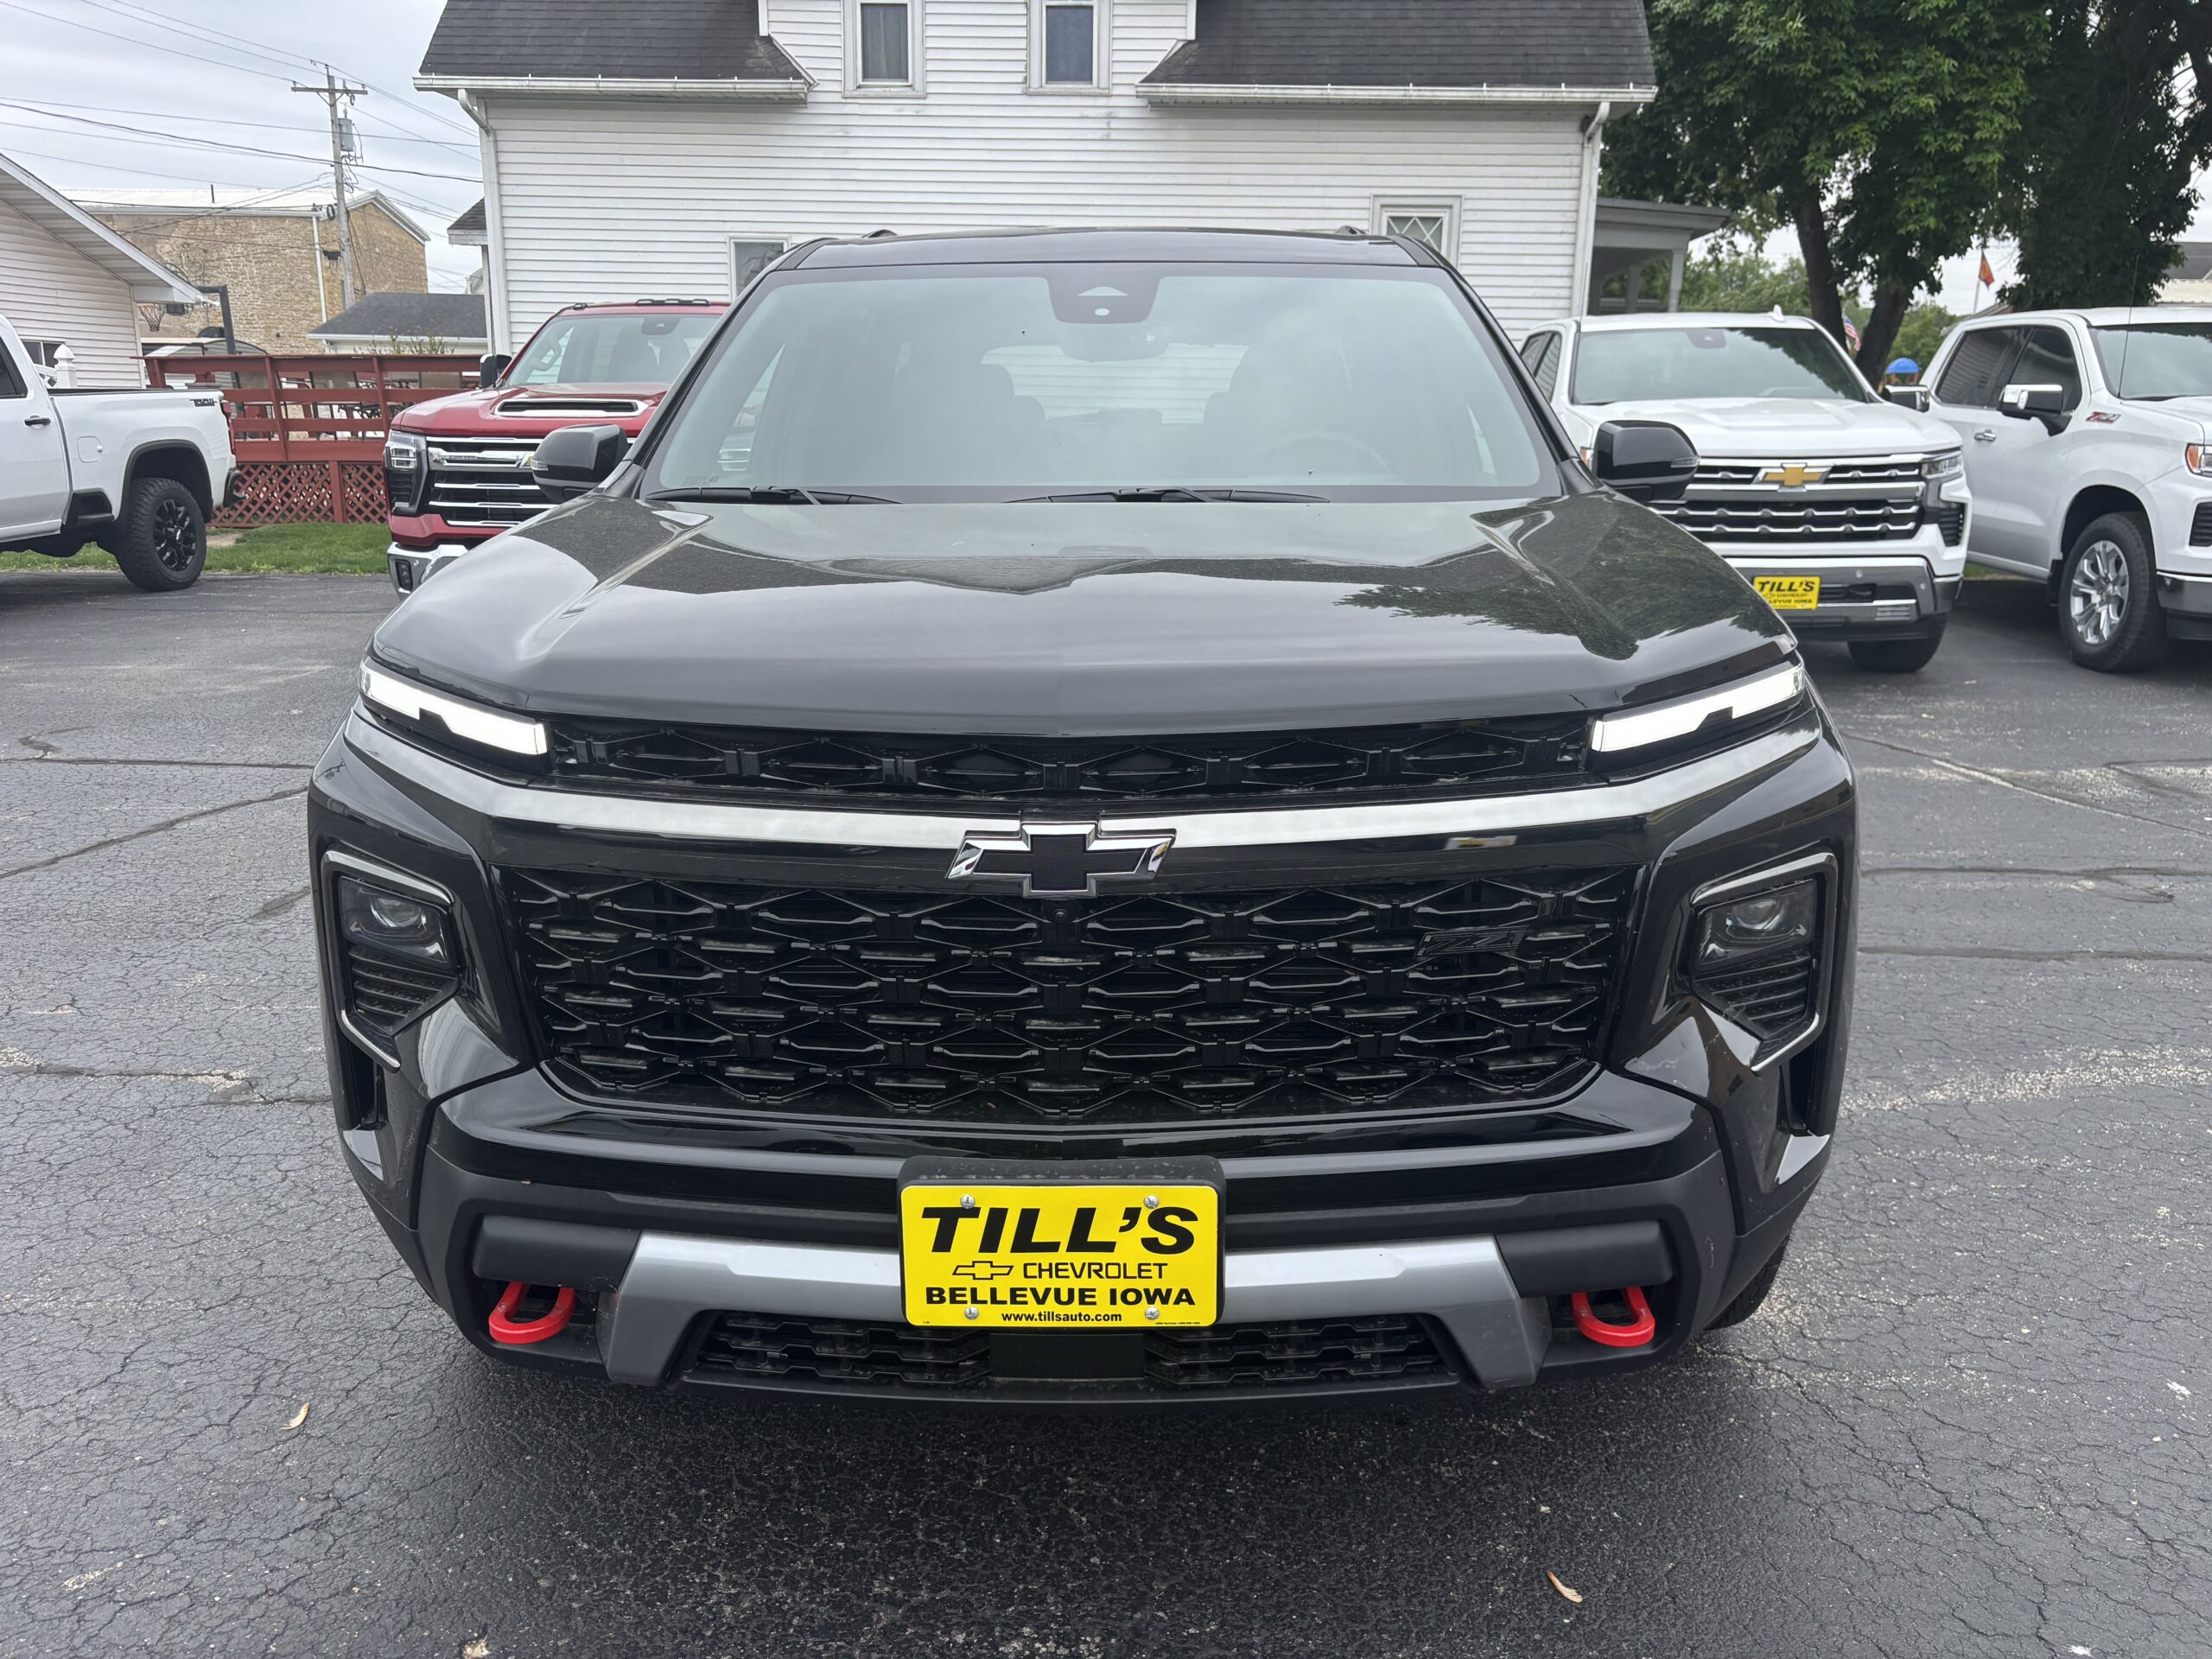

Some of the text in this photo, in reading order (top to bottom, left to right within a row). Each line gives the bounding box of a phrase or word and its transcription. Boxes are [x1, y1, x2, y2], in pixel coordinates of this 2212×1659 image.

[1758, 581, 1815, 593] TILL'S
[922, 1206, 1198, 1255] TILL'S
[1023, 1262, 1168, 1280] CHEVROLET
[926, 1287, 1196, 1306] BELLEVUE IOWA
[1001, 1311, 1122, 1322] www.tillsauto.com
